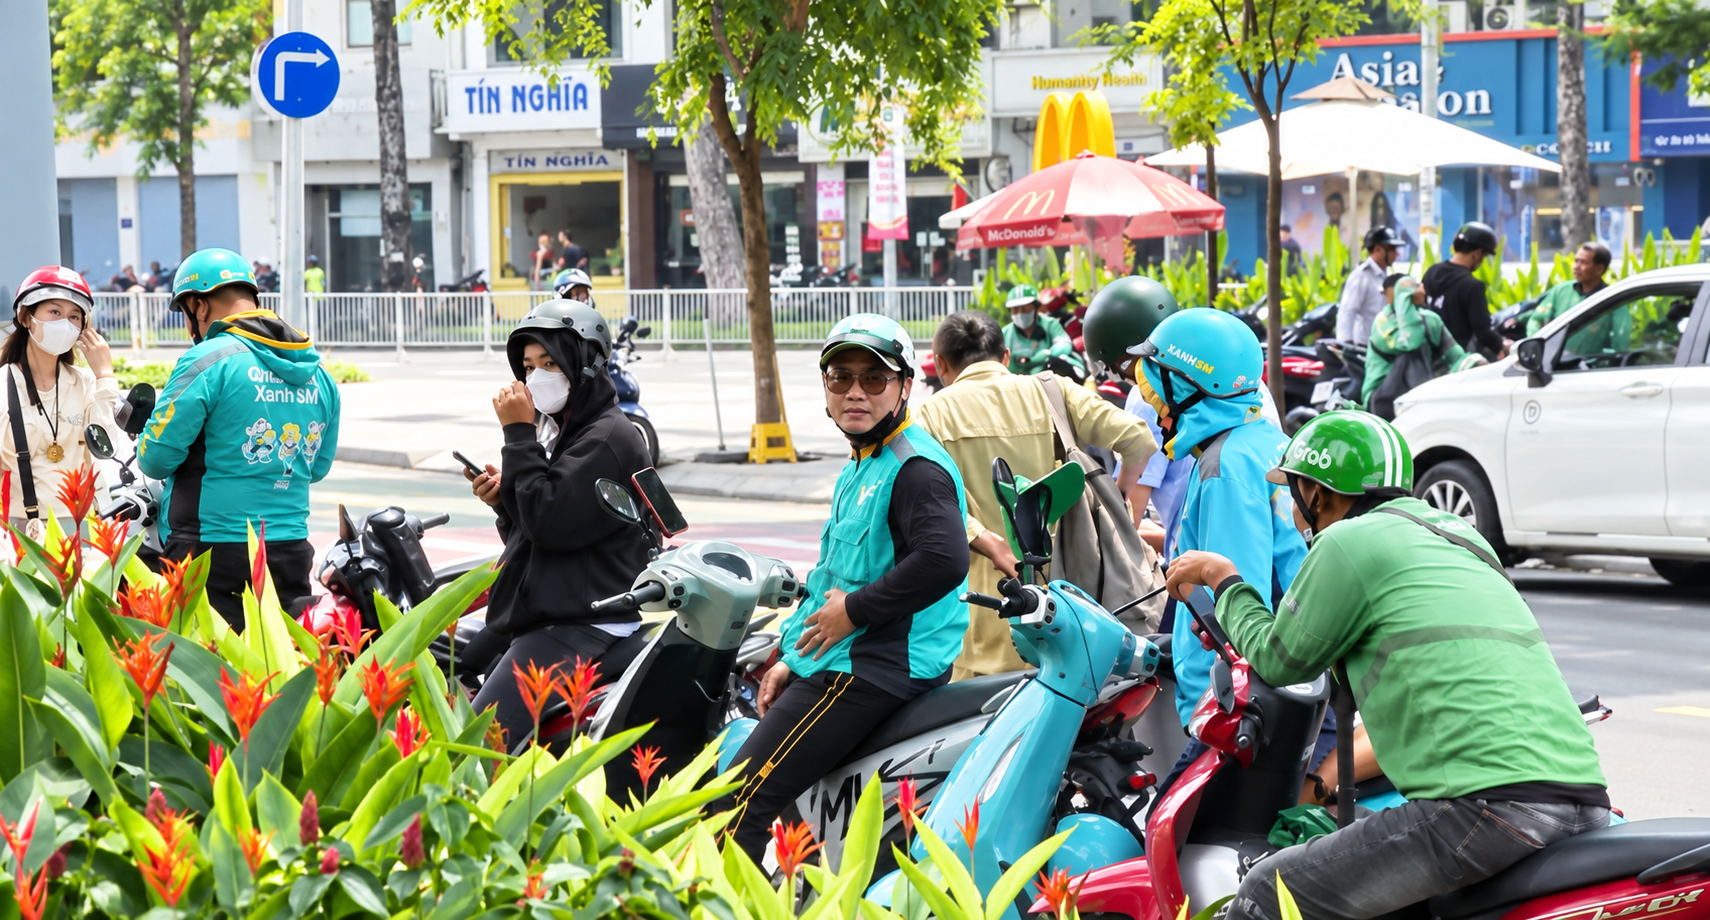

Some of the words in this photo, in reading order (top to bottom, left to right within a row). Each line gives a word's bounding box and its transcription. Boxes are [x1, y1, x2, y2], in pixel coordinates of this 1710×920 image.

[1330, 50, 1420, 87] Asia
[1031, 74, 1100, 91] Humanity
[1102, 71, 1148, 87] Health
[465, 77, 501, 115] TÍN
[511, 75, 589, 113] NGHĨA
[503, 153, 537, 168] TÍN
[546, 151, 609, 167] NGHĨA
[253, 384, 294, 404] Xanh
[296, 387, 319, 405] SM
